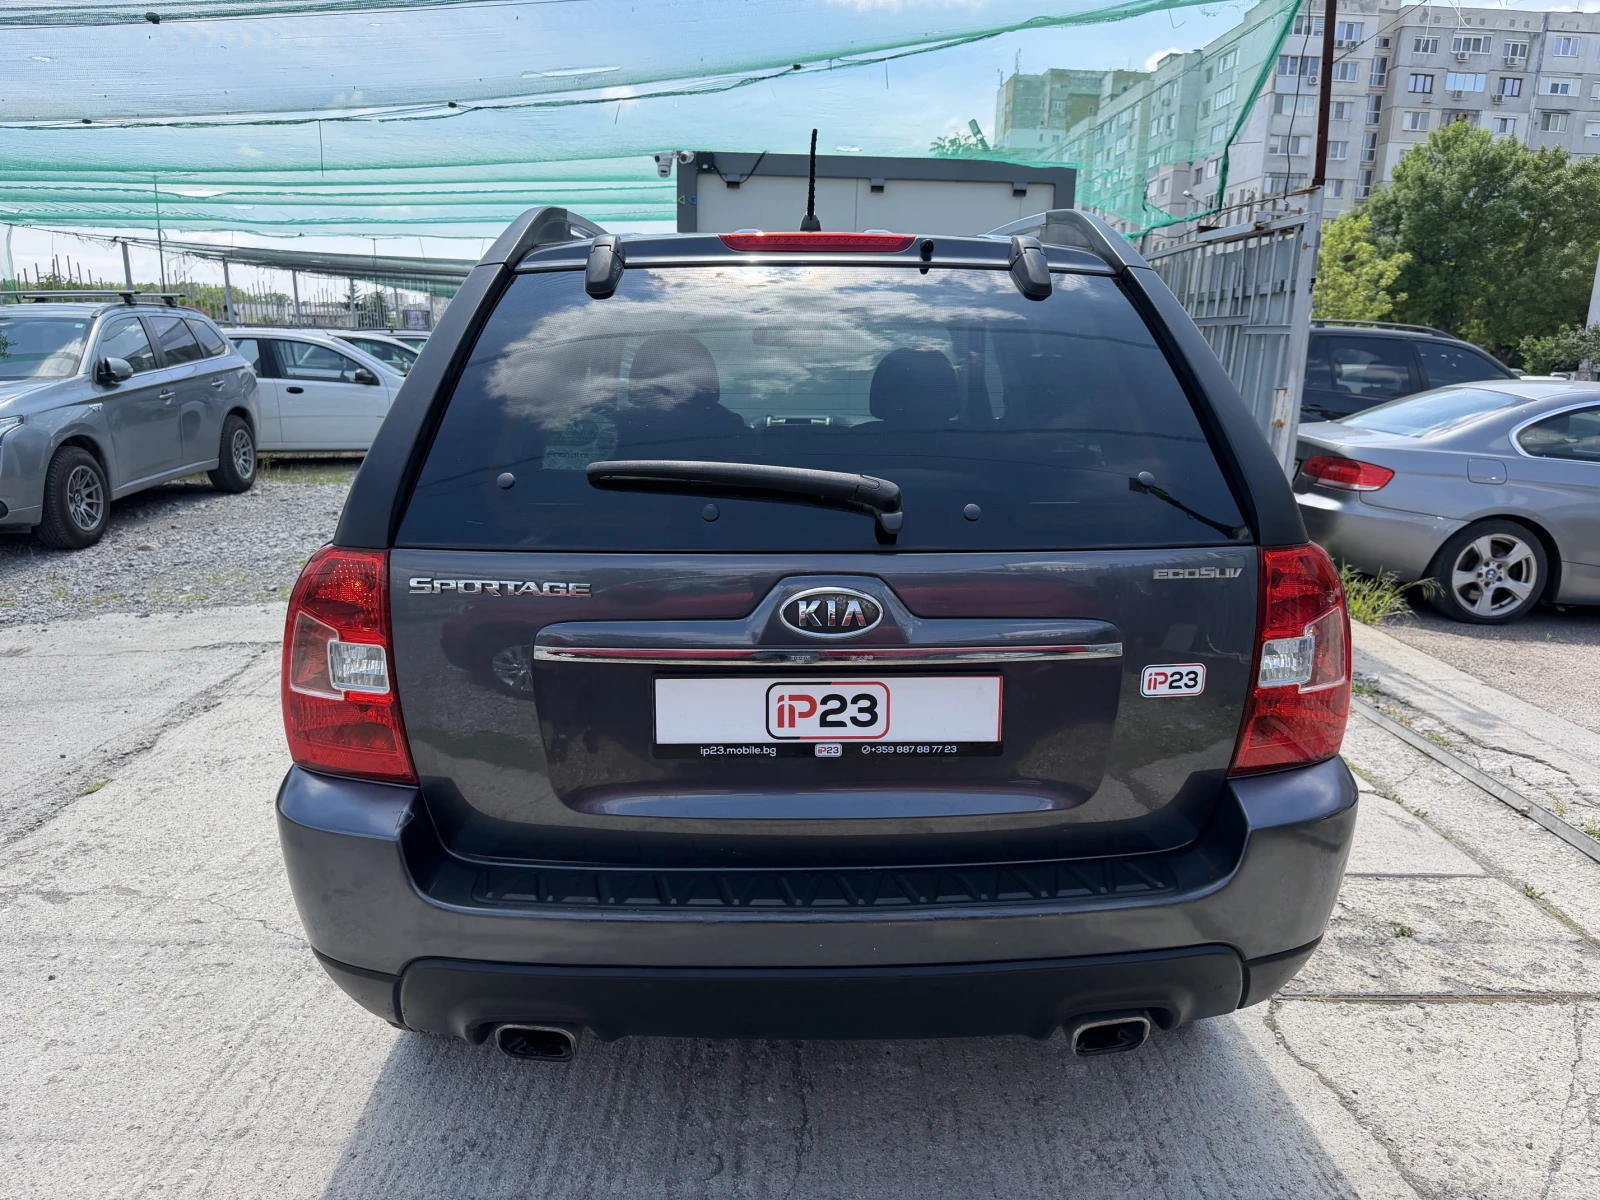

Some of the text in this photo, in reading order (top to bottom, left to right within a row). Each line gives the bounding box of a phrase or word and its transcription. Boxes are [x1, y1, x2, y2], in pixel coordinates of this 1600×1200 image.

[409, 578, 591, 597] SPORTAGE
[798, 600, 866, 626] KIA
[700, 746, 776, 757] ip23.mobile.bg
[897, 745, 914, 753] 887
[917, 745, 930, 753] 88
[932, 745, 943, 753] 77
[945, 745, 957, 753] 23
